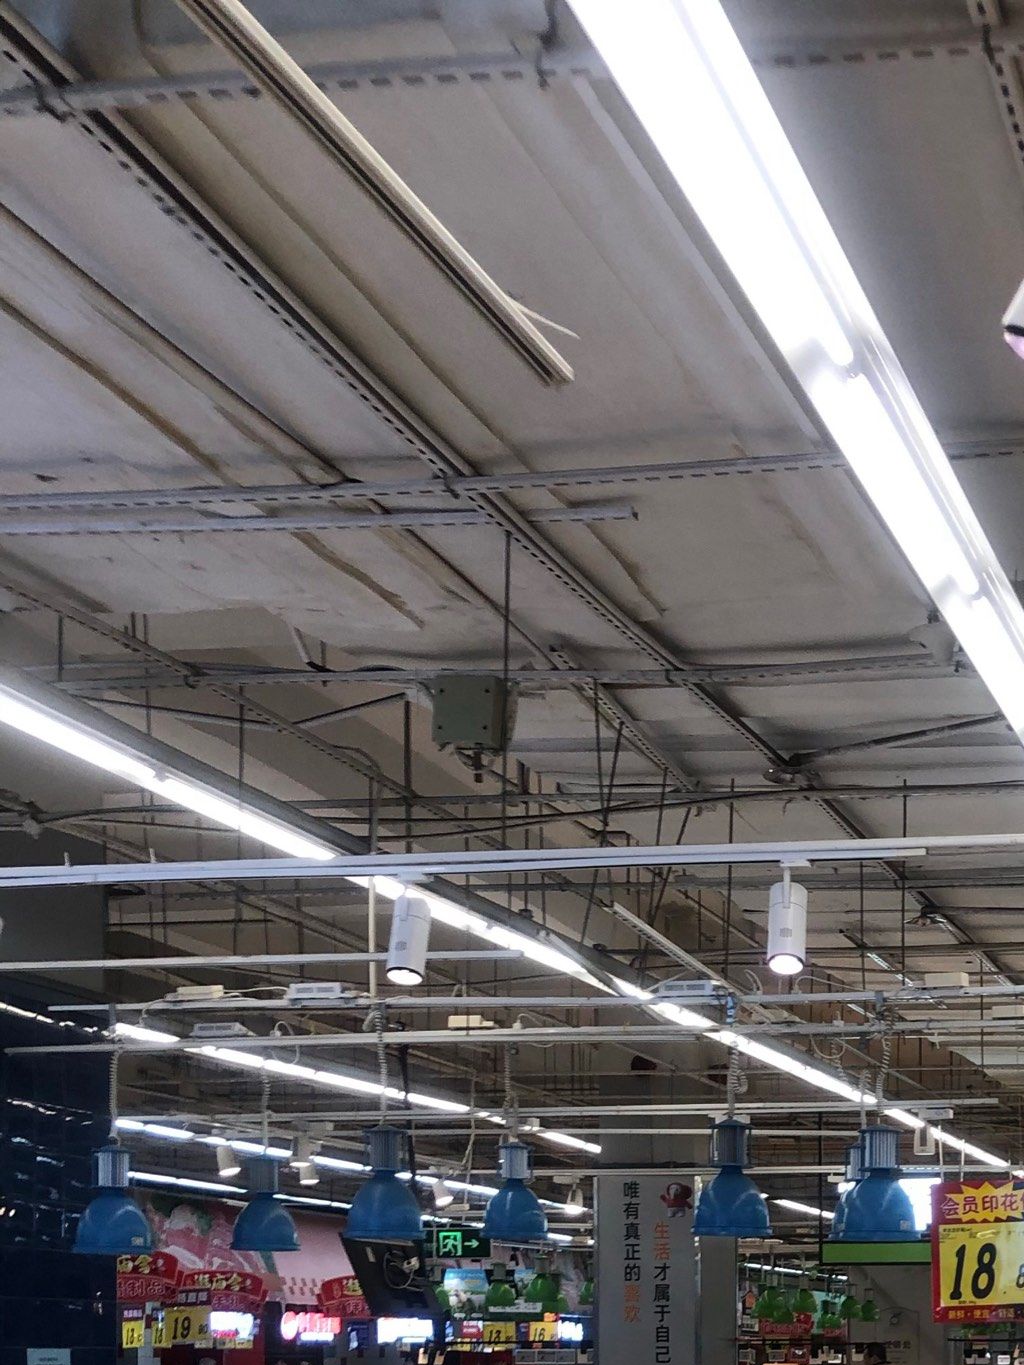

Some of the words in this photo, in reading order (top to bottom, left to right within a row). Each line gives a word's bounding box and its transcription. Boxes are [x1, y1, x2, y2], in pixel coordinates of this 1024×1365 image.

[623, 1181, 641, 1323] 唯有真正的喜欢
[653, 1221, 671, 1363] 生活才属于自己
[949, 1242, 997, 1300] 18
